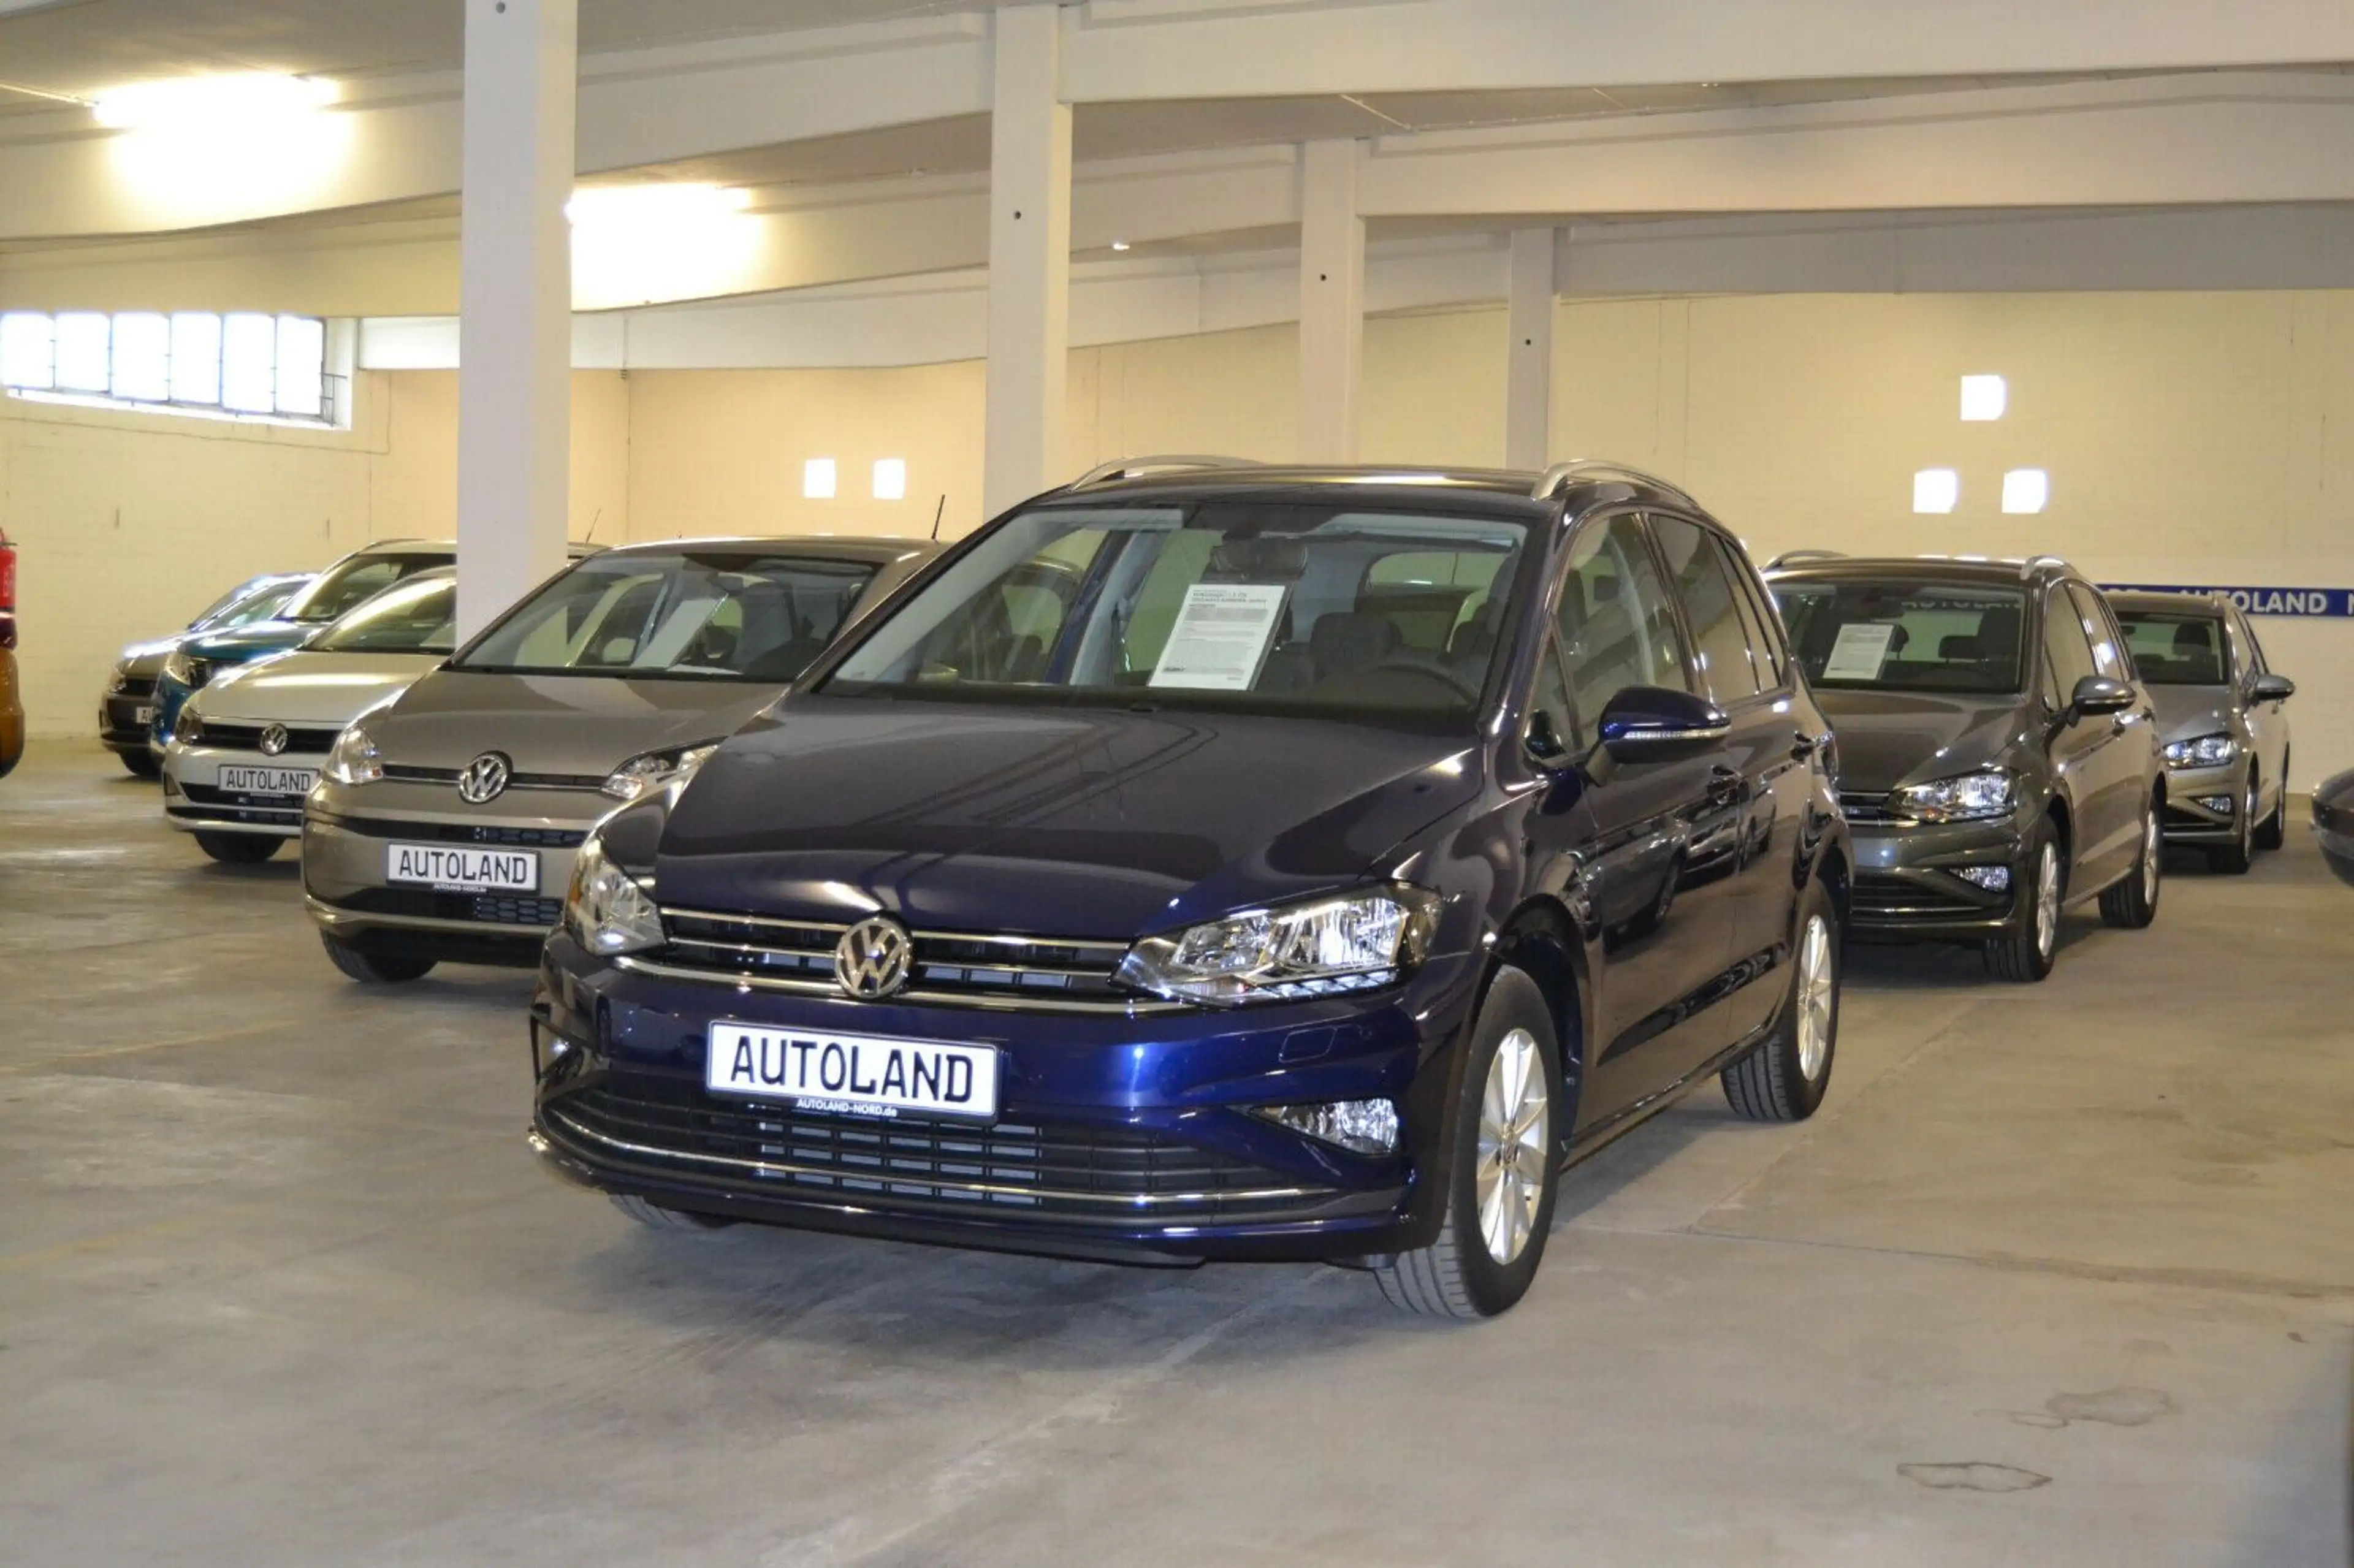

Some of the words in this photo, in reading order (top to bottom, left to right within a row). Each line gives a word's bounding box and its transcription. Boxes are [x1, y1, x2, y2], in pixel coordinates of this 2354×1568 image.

[226, 769, 310, 792] AUTOLAND
[400, 850, 527, 883] AUTOLAND
[731, 1035, 973, 1103] AUTOLAND
[796, 1098, 897, 1117] AUTOLAND-NORD.de
